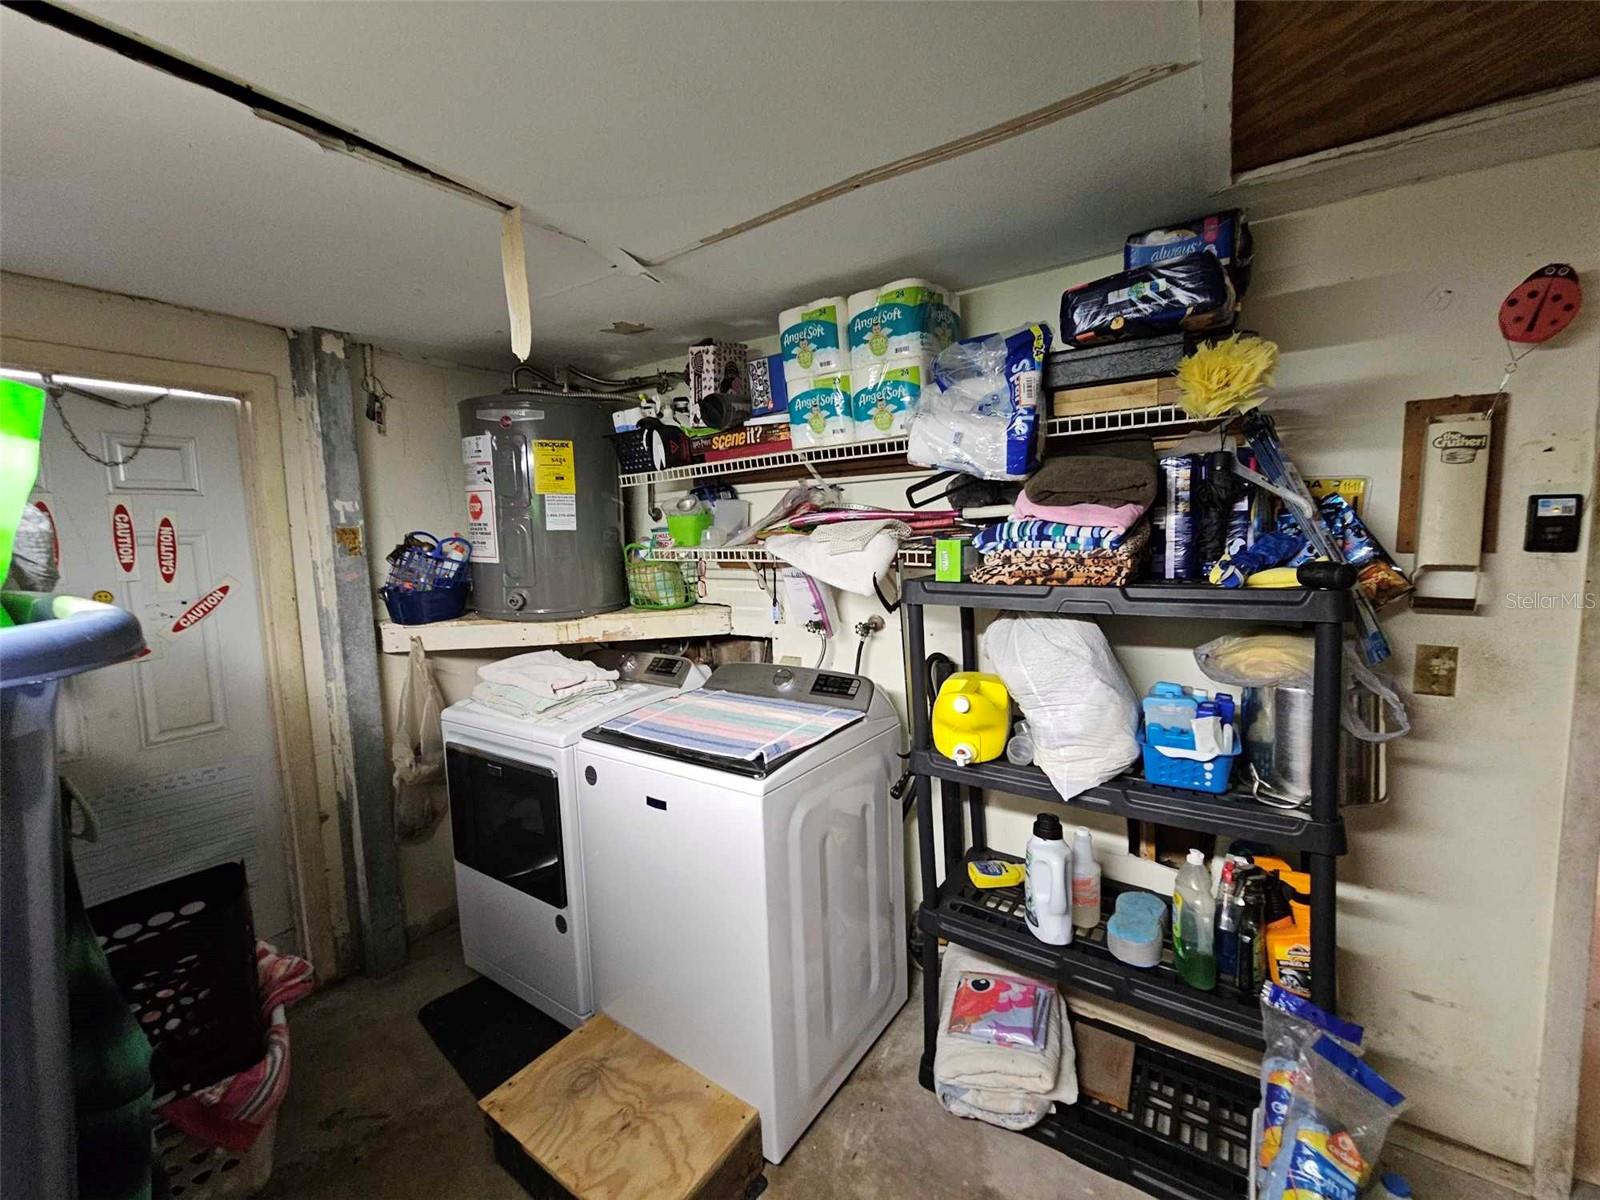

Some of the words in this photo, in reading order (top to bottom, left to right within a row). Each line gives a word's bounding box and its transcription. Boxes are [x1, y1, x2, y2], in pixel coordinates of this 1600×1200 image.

[1151, 242, 1197, 261] always
[853, 314, 882, 333] Angel
[881, 307, 903, 324] Soft
[783, 330, 807, 346] Angel
[807, 323, 825, 340] Soft
[794, 395, 818, 411] Angel
[857, 388, 886, 407] Angel
[712, 431, 746, 450] scene
[746, 426, 763, 444] it?
[114, 513, 134, 564] CAUTION
[160, 526, 175, 574] CAUTION
[180, 590, 225, 627] CAUTION
